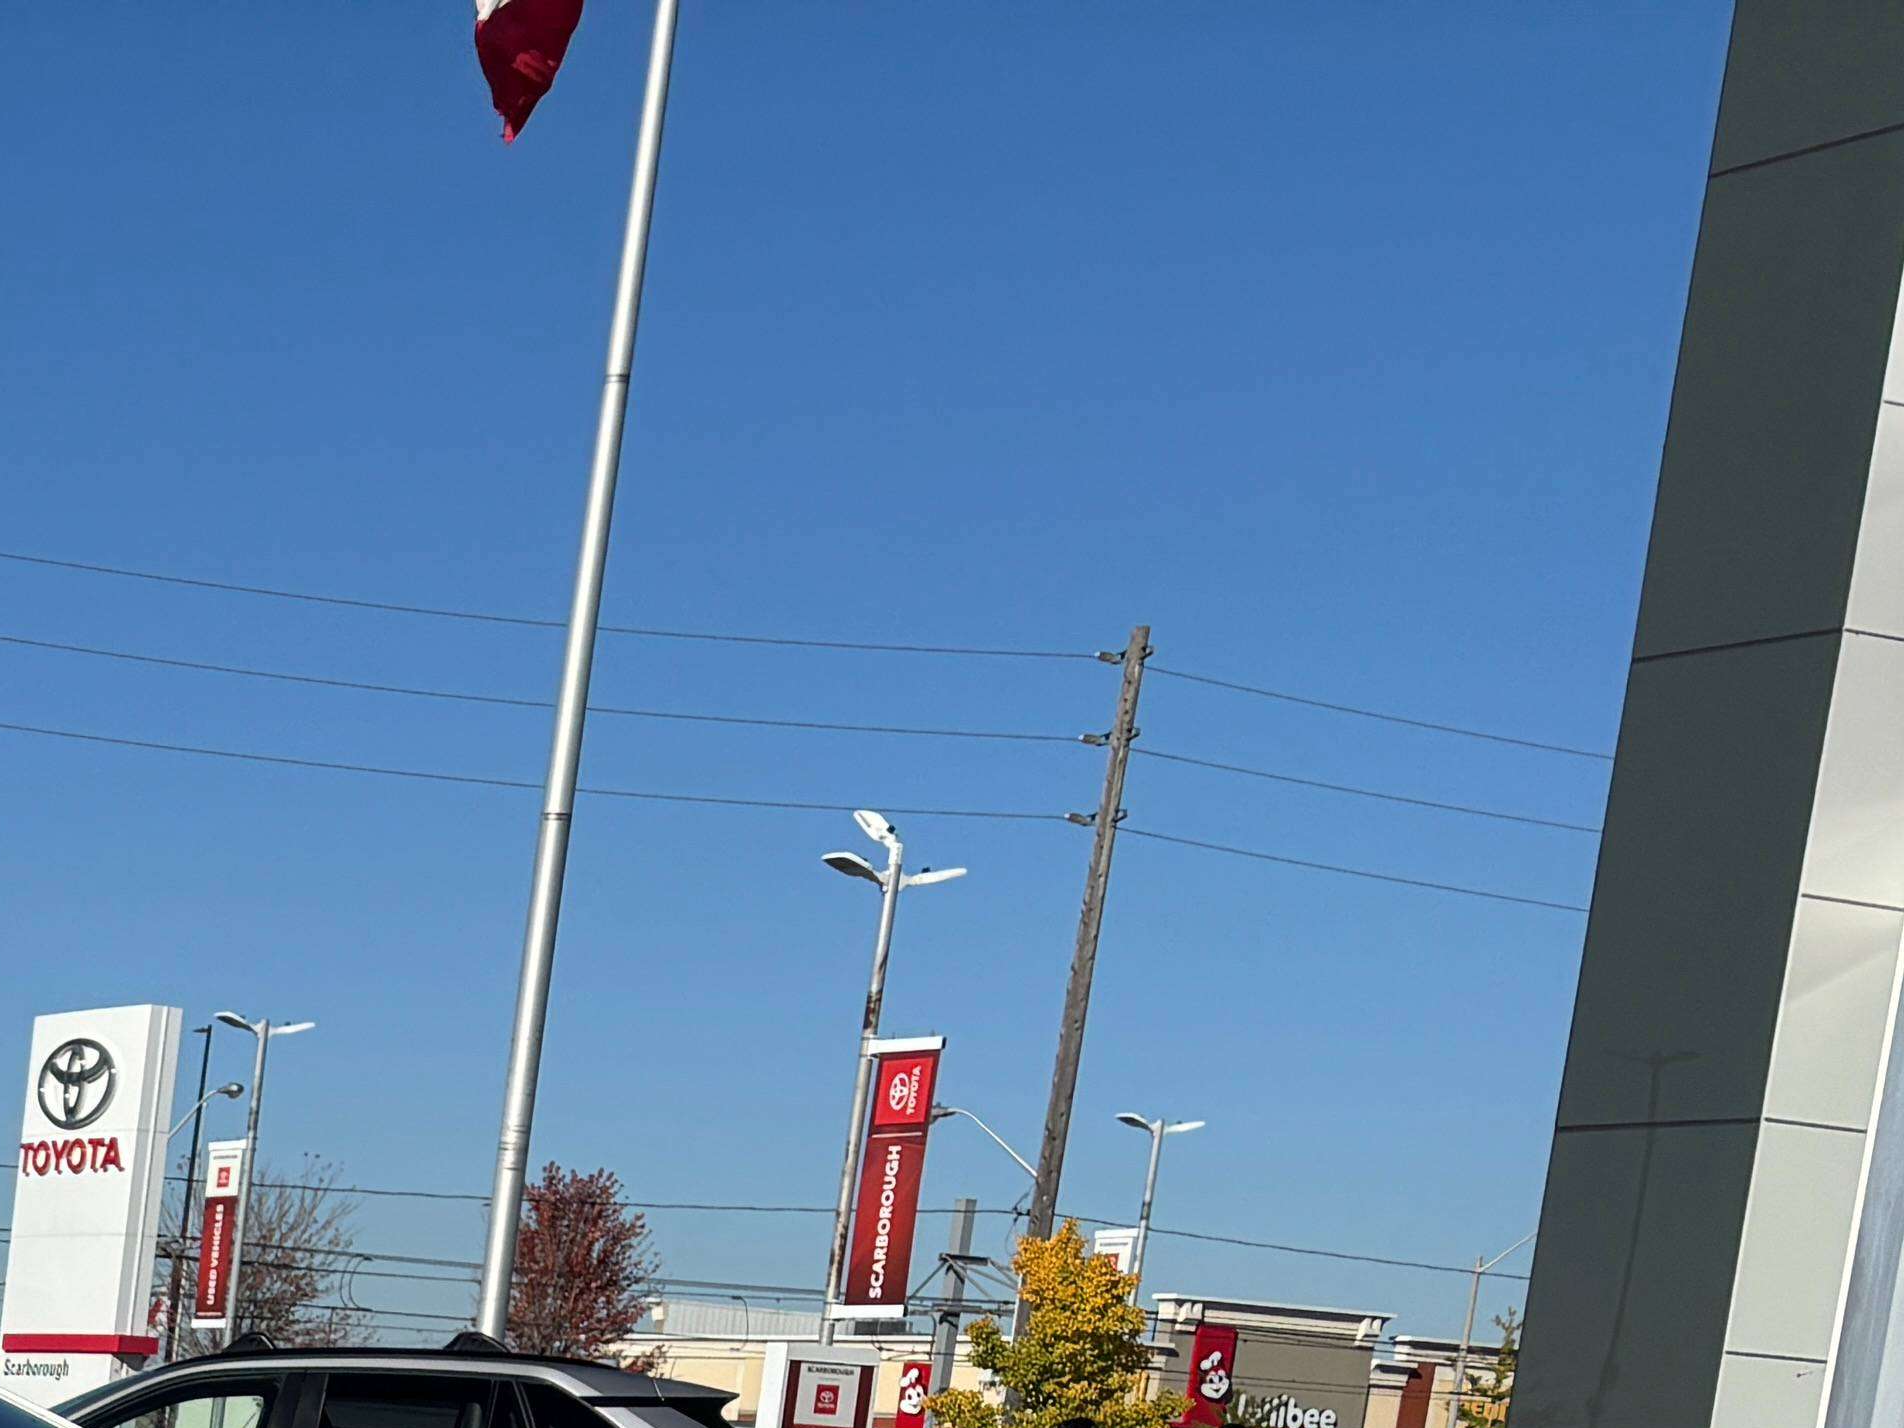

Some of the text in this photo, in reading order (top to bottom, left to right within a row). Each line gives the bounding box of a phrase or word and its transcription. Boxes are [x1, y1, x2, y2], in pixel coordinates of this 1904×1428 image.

[906, 1065, 922, 1115] TOYOTA
[20, 1137, 125, 1176] TOYOTA
[869, 1145, 902, 1299] SCARBOROUGH
[3, 1358, 70, 1380] Scarborough
